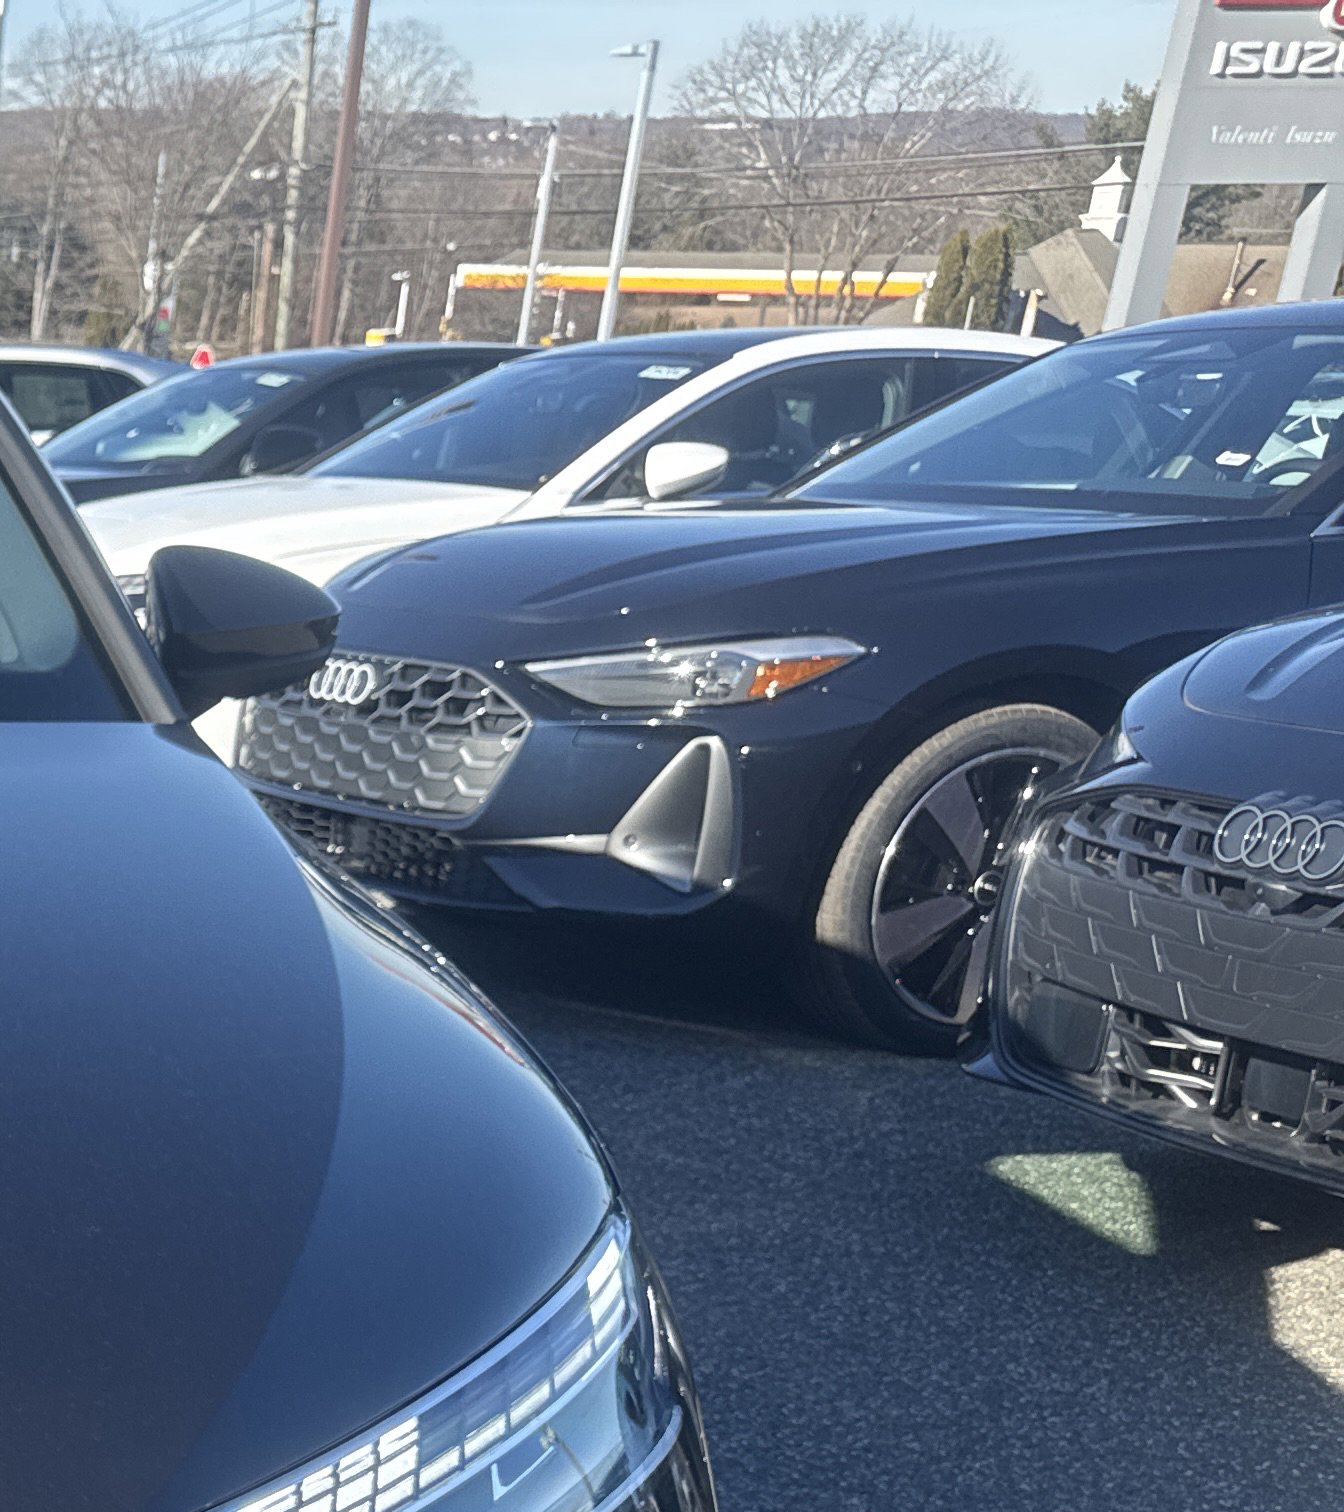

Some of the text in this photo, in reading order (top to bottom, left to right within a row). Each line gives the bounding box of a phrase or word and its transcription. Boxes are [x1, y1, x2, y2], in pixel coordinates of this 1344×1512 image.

[1209, 40, 1344, 75] ISUZ
[1211, 125, 1338, 144] Valenti Isuzu
